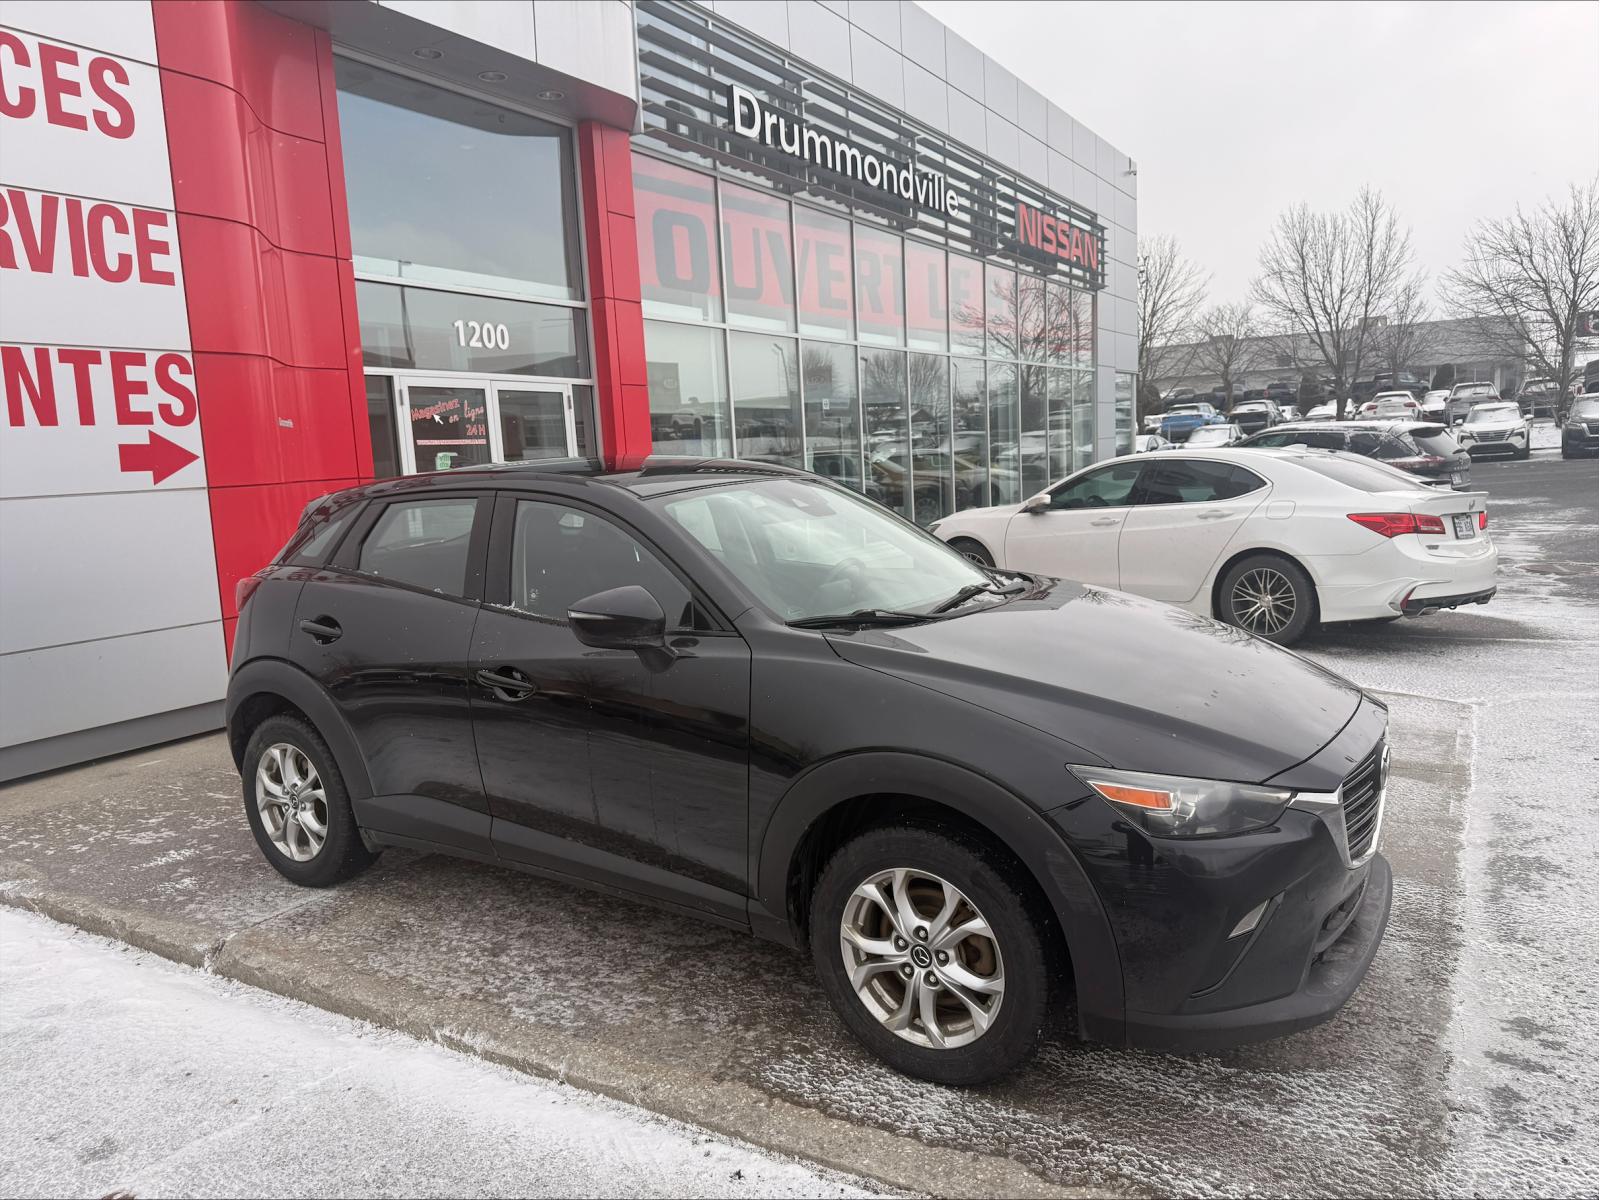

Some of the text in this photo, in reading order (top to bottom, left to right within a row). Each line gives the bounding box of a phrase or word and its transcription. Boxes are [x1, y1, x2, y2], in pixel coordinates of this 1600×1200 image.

[0, 31, 136, 139] CES
[731, 84, 960, 217] Drummondville
[651, 208, 909, 316] OUVERT
[1017, 201, 1099, 272] NISSAN
[453, 319, 510, 351] 1200
[0, 346, 197, 426] NTES
[448, 414, 460, 424] en
[464, 399, 485, 422] ligne
